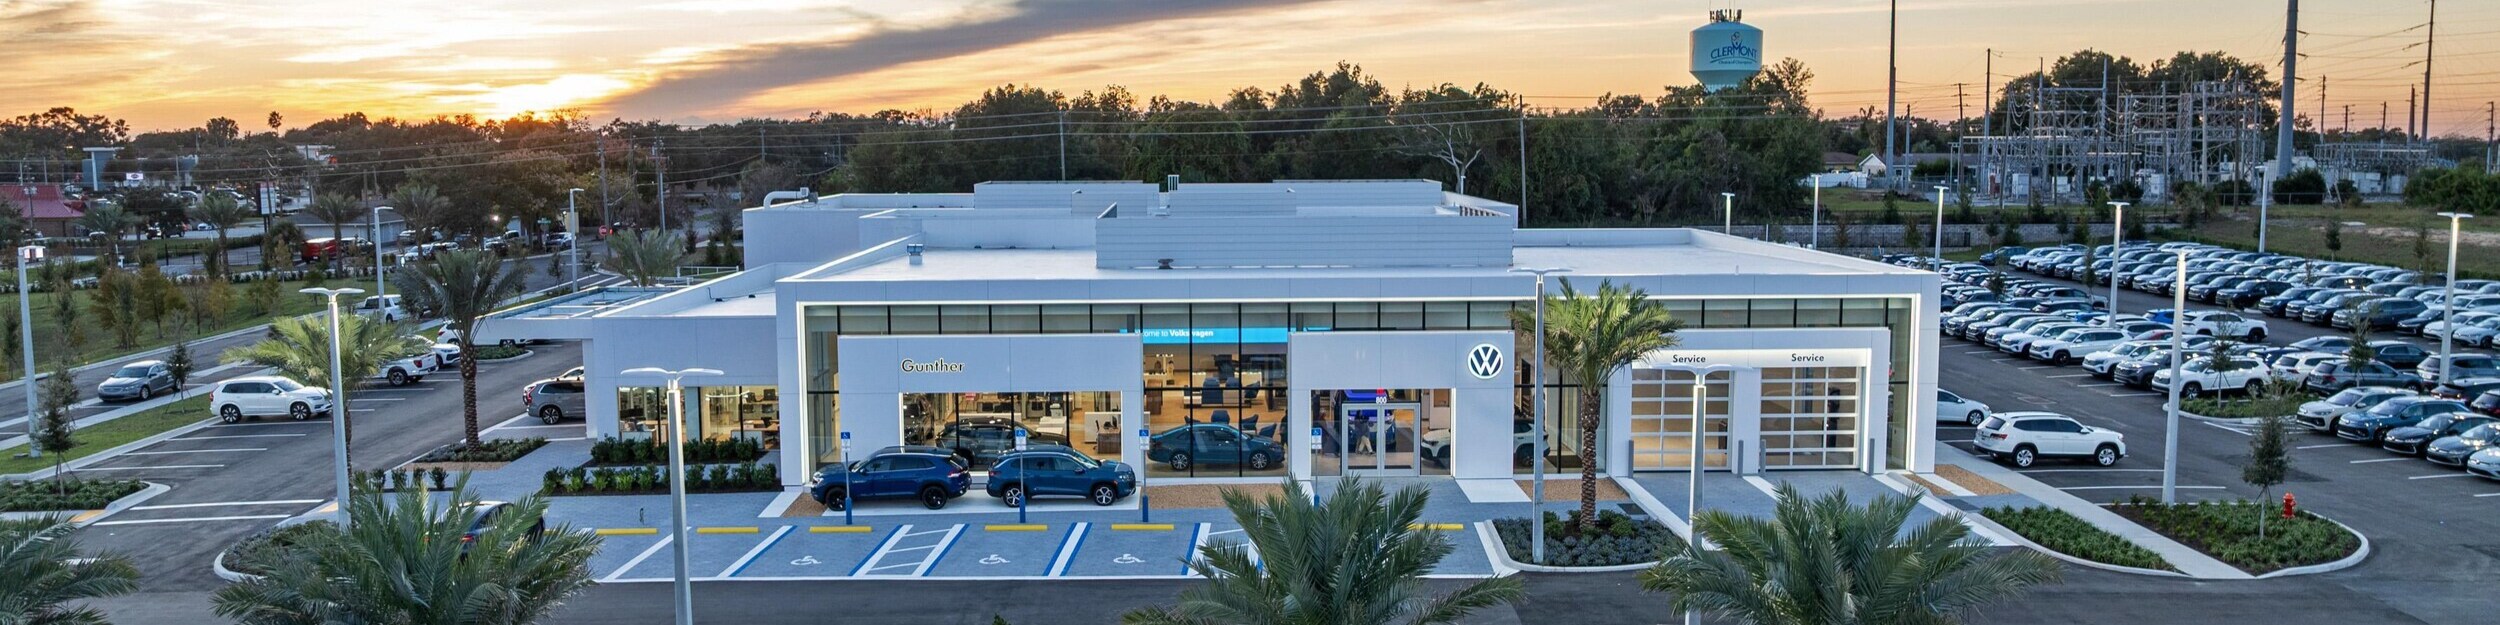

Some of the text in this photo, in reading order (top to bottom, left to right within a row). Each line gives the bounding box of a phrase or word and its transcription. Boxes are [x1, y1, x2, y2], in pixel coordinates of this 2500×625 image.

[1710, 42, 1757, 59] CLERMONT
[1672, 354, 1706, 363] Service
[1790, 353, 1825, 362] Service
[901, 357, 965, 373] Gunther
